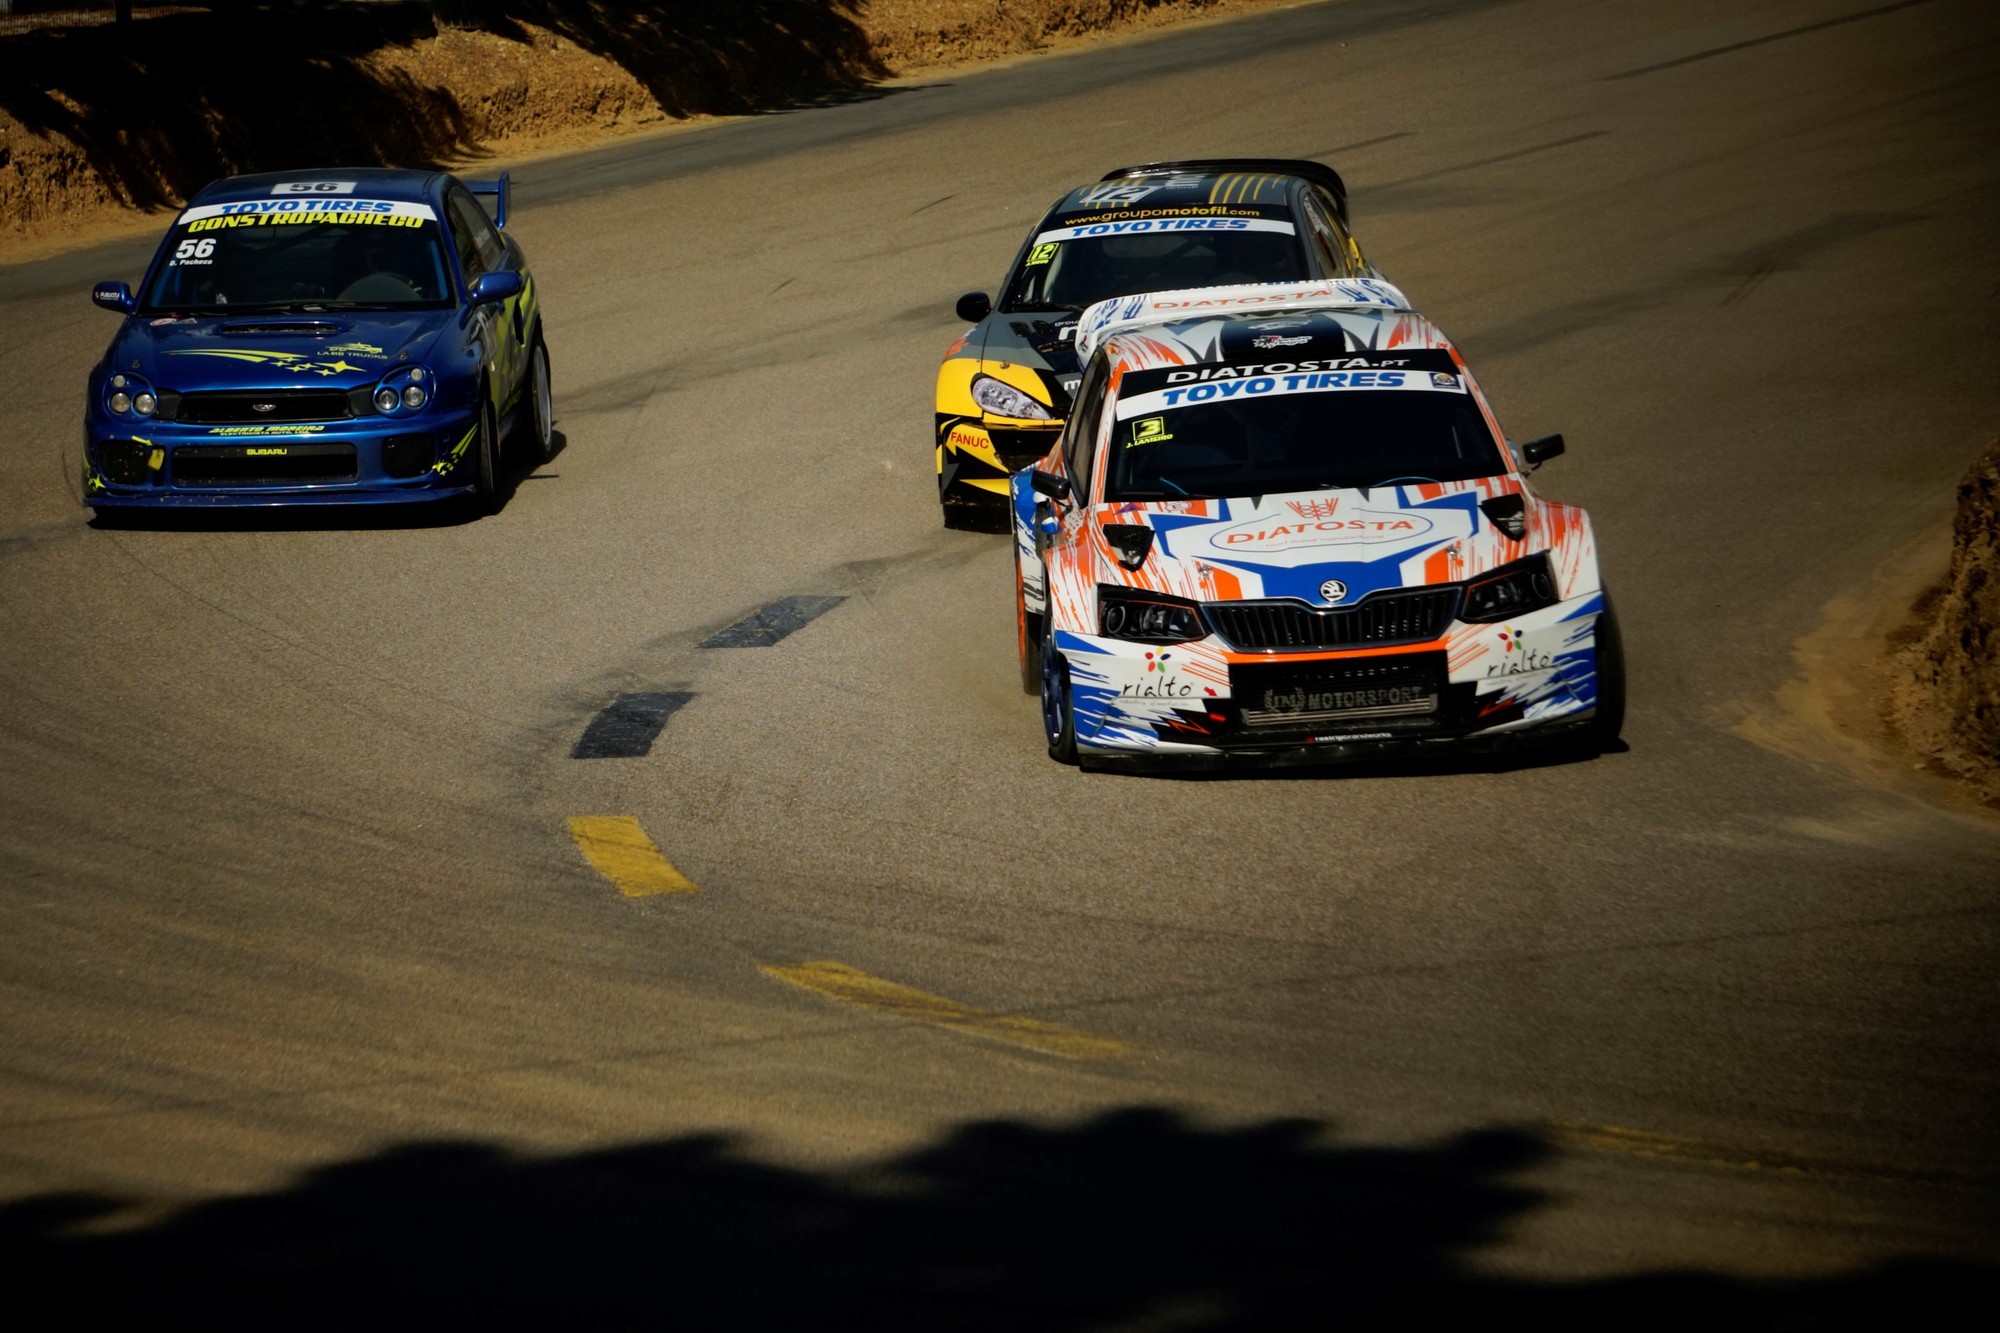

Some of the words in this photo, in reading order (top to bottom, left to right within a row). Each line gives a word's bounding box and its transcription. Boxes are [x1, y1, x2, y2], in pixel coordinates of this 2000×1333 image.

[289, 182, 338, 192] 56
[222, 201, 299, 214] TOYO
[304, 201, 394, 212] TIRES
[1064, 206, 1260, 226] www.groupomotofil.com
[188, 211, 424, 233] CONSTROPACHECO
[1072, 221, 1151, 237] TOYO
[1158, 219, 1250, 231] TIRES
[176, 238, 217, 259] 56
[1031, 243, 1055, 260] 12
[1153, 290, 1332, 309] DIATOSTA
[347, 352, 388, 360] TRUCKS
[1163, 376, 1274, 406] TOYO
[1282, 372, 1406, 390] TIRES
[1138, 420, 1161, 438] 3
[950, 432, 989, 449] FANUC
[246, 448, 288, 456] SUBARU
[1227, 520, 1413, 543] DIATOSTA
[1487, 648, 1549, 677] rialto
[1122, 675, 1191, 697] rialto
[1308, 686, 1422, 710] MOTORSPORT
